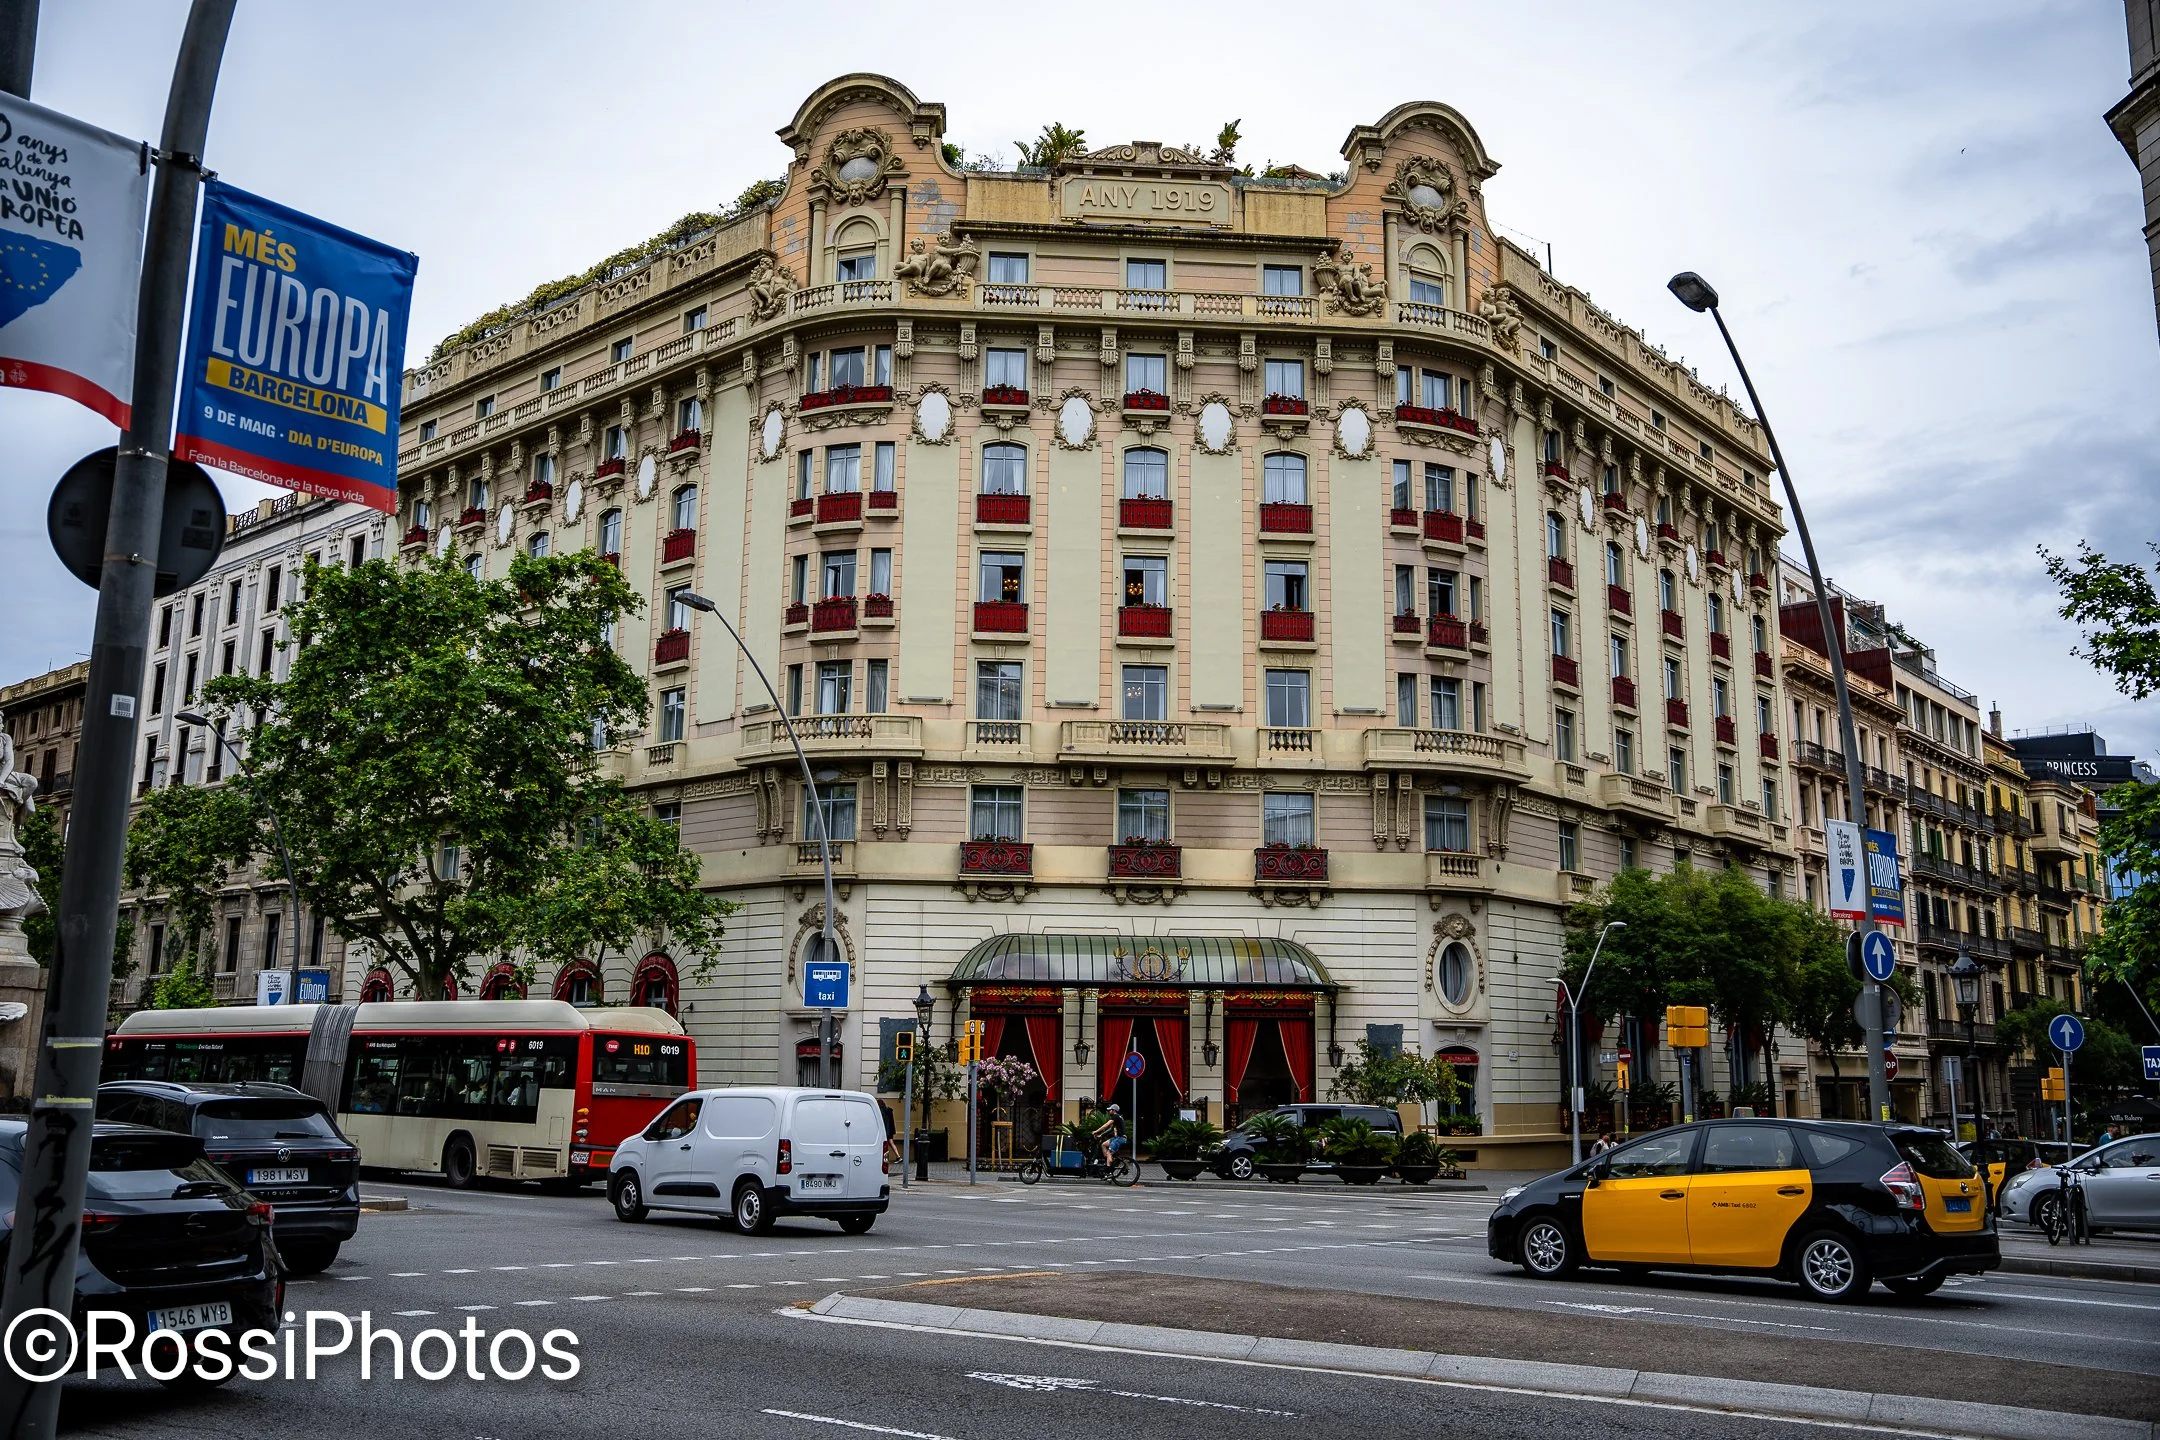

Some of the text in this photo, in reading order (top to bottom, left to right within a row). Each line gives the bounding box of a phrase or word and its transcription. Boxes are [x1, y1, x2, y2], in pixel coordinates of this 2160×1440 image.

[17, 135, 68, 165] anys
[27, 152, 42, 165] de
[0, 149, 72, 190] alunya
[1079, 184, 1216, 212] ANY 1919
[223, 223, 297, 273] MÉS
[212, 255, 390, 406] EUROPA
[228, 366, 369, 425] BARCELONA
[203, 405, 214, 420] 9
[217, 410, 236, 427] DE
[239, 416, 276, 438] MAIG
[288, 430, 313, 448] DIA
[188, 449, 365, 503] Fem la Barcelona de la teva vida
[299, 983, 326, 1001] EUROPA
[818, 991, 835, 1001] taxi
[528, 1040, 544, 1050] 6019
[633, 1044, 651, 1056] H10
[660, 1045, 681, 1055] 6019
[1884, 1061, 1897, 1070] OP
[2124, 1115, 2144, 1123] Bakery
[256, 1169, 305, 1181] 1981 MSV
[805, 1180, 823, 1188] 8490
[160, 1304, 228, 1329] 1546 MYB
